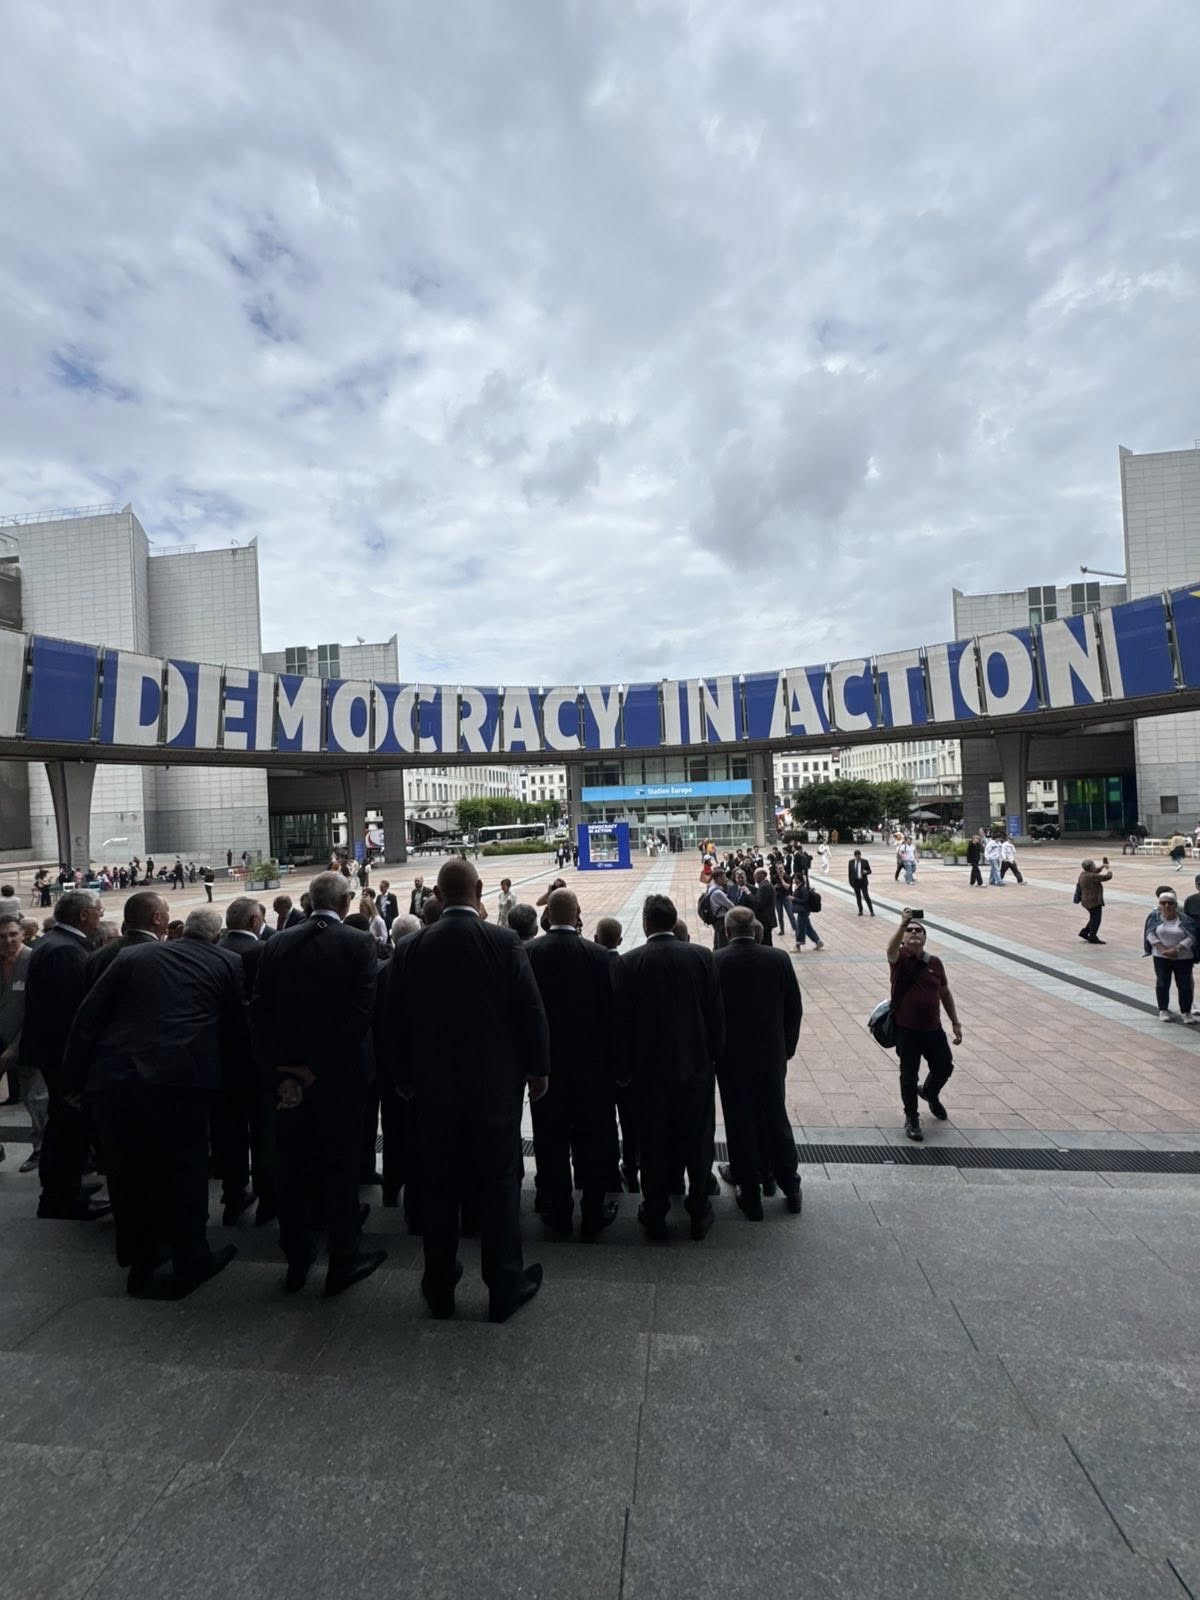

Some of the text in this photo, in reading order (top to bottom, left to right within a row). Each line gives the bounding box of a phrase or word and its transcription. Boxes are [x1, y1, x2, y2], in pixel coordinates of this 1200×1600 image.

[113, 609, 1124, 754] DEMOCRACY IN ACTION
[671, 786, 692, 794] Europe
